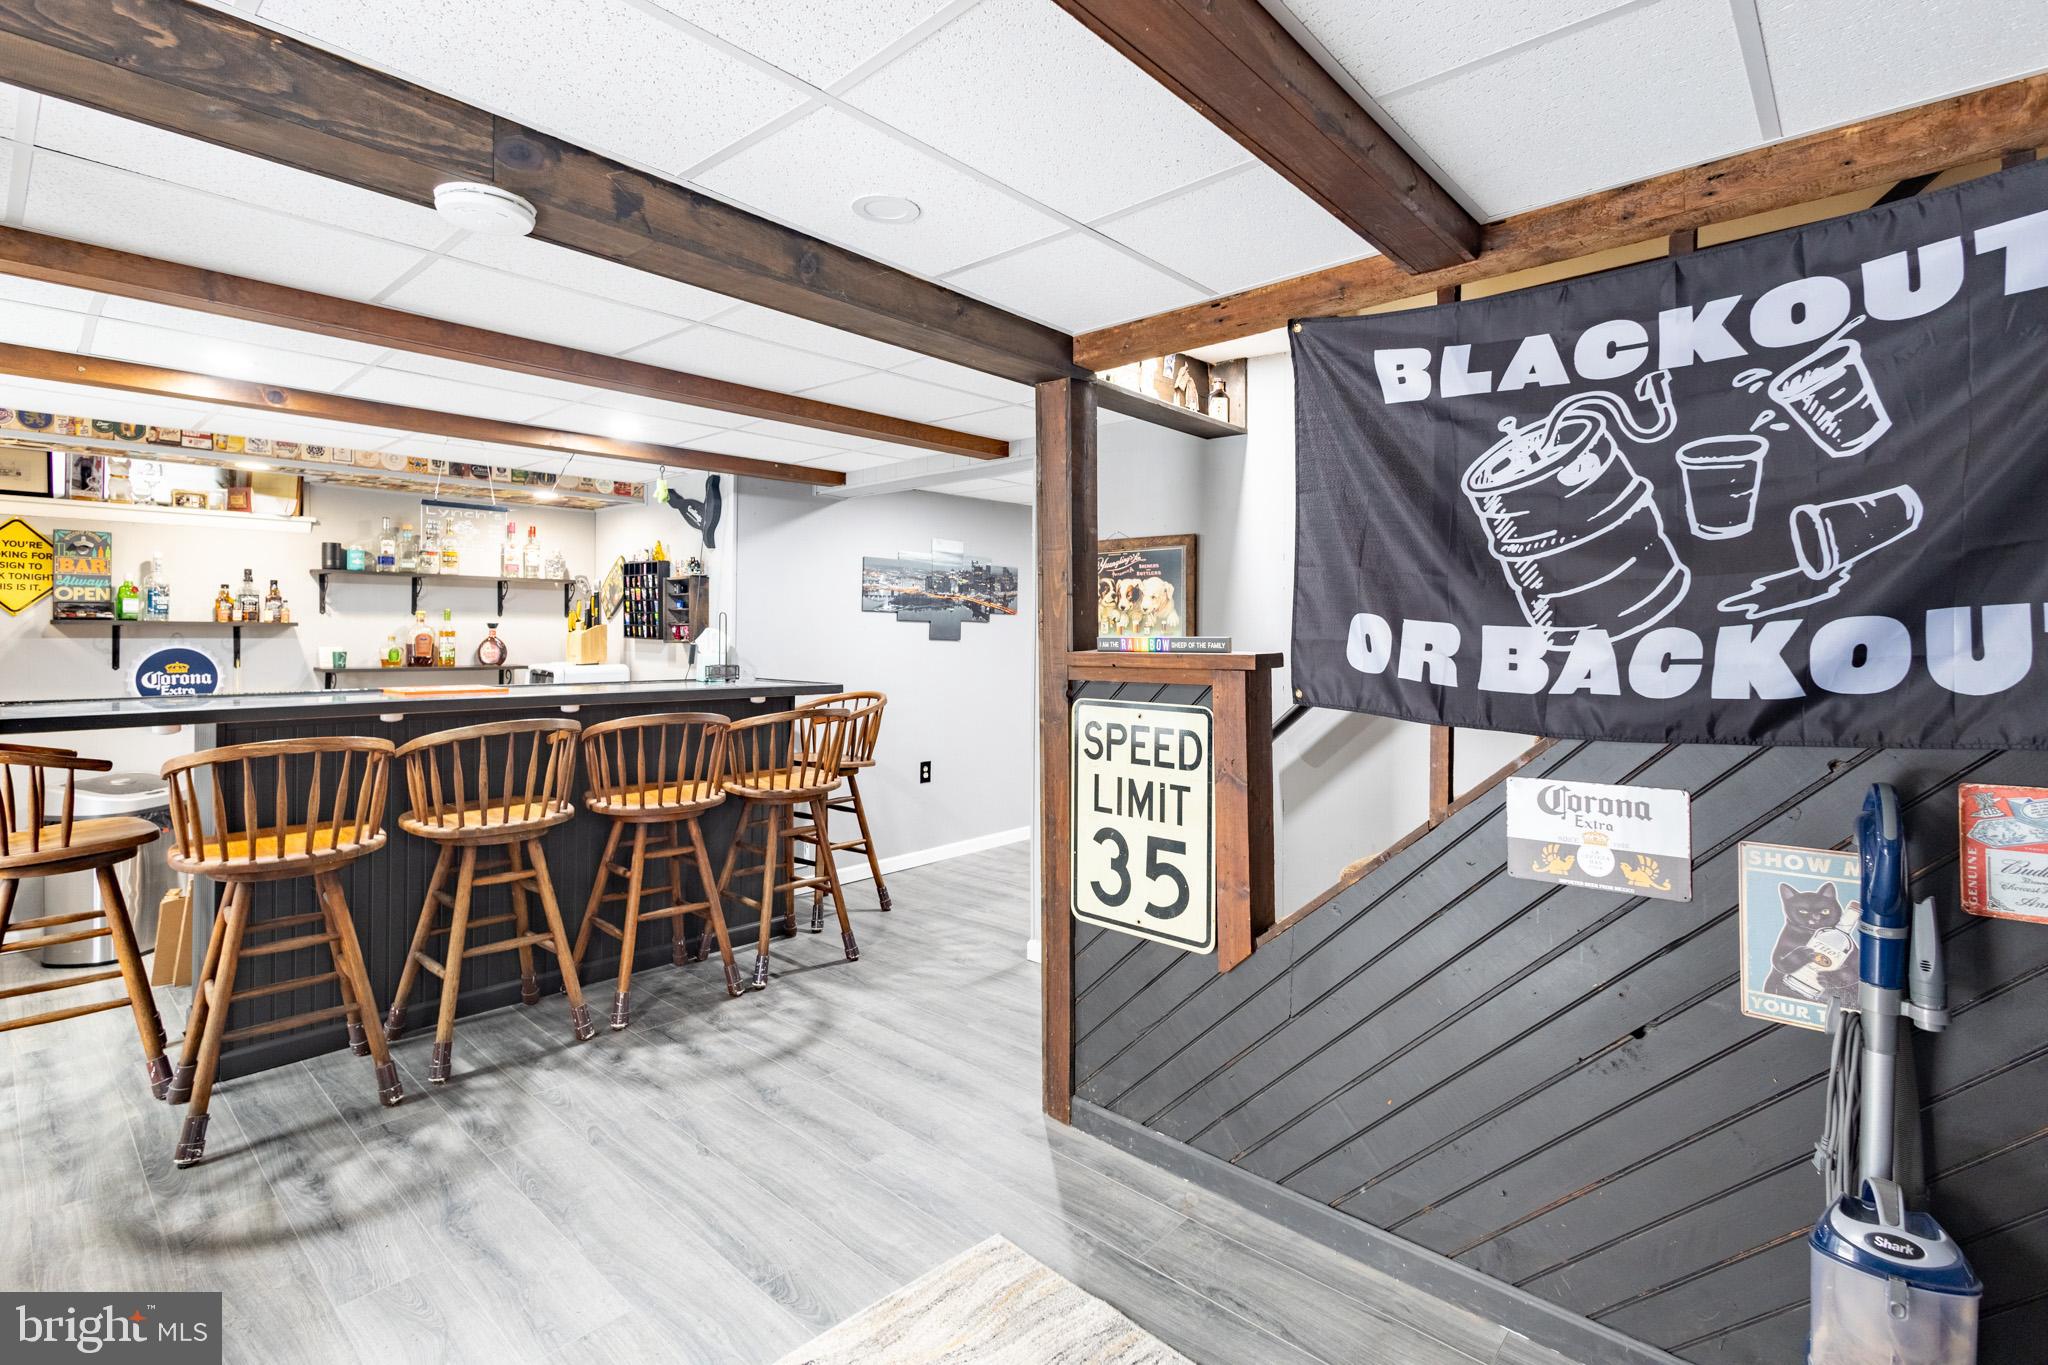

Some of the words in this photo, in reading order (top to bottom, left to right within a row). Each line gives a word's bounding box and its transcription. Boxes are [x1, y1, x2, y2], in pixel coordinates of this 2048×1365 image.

[1373, 209, 2048, 405] BLACKOUT
[2, 540, 43, 549] YOU'RE
[31, 552, 53, 560] FOR
[60, 557, 106, 573] BAR
[56, 575, 110, 588] Always
[55, 587, 110, 601] OPEN
[1121, 638, 1170, 651] RAINBOW
[1346, 613, 1459, 687] OR
[1478, 602, 2048, 700] BACKOU
[141, 671, 212, 690] Corona
[161, 685, 196, 696] Extra
[1084, 721, 1203, 771] SPEED
[1094, 774, 1191, 826] LIMIT
[1537, 784, 1653, 821] Corona
[1575, 814, 1614, 832] Extra
[1749, 851, 1831, 874] SHOW
[1090, 827, 1190, 920] 35
[1967, 847, 1979, 905] GENUINE
[1752, 996, 1811, 1020] YOUR
[1874, 1235, 1914, 1256] Shark
